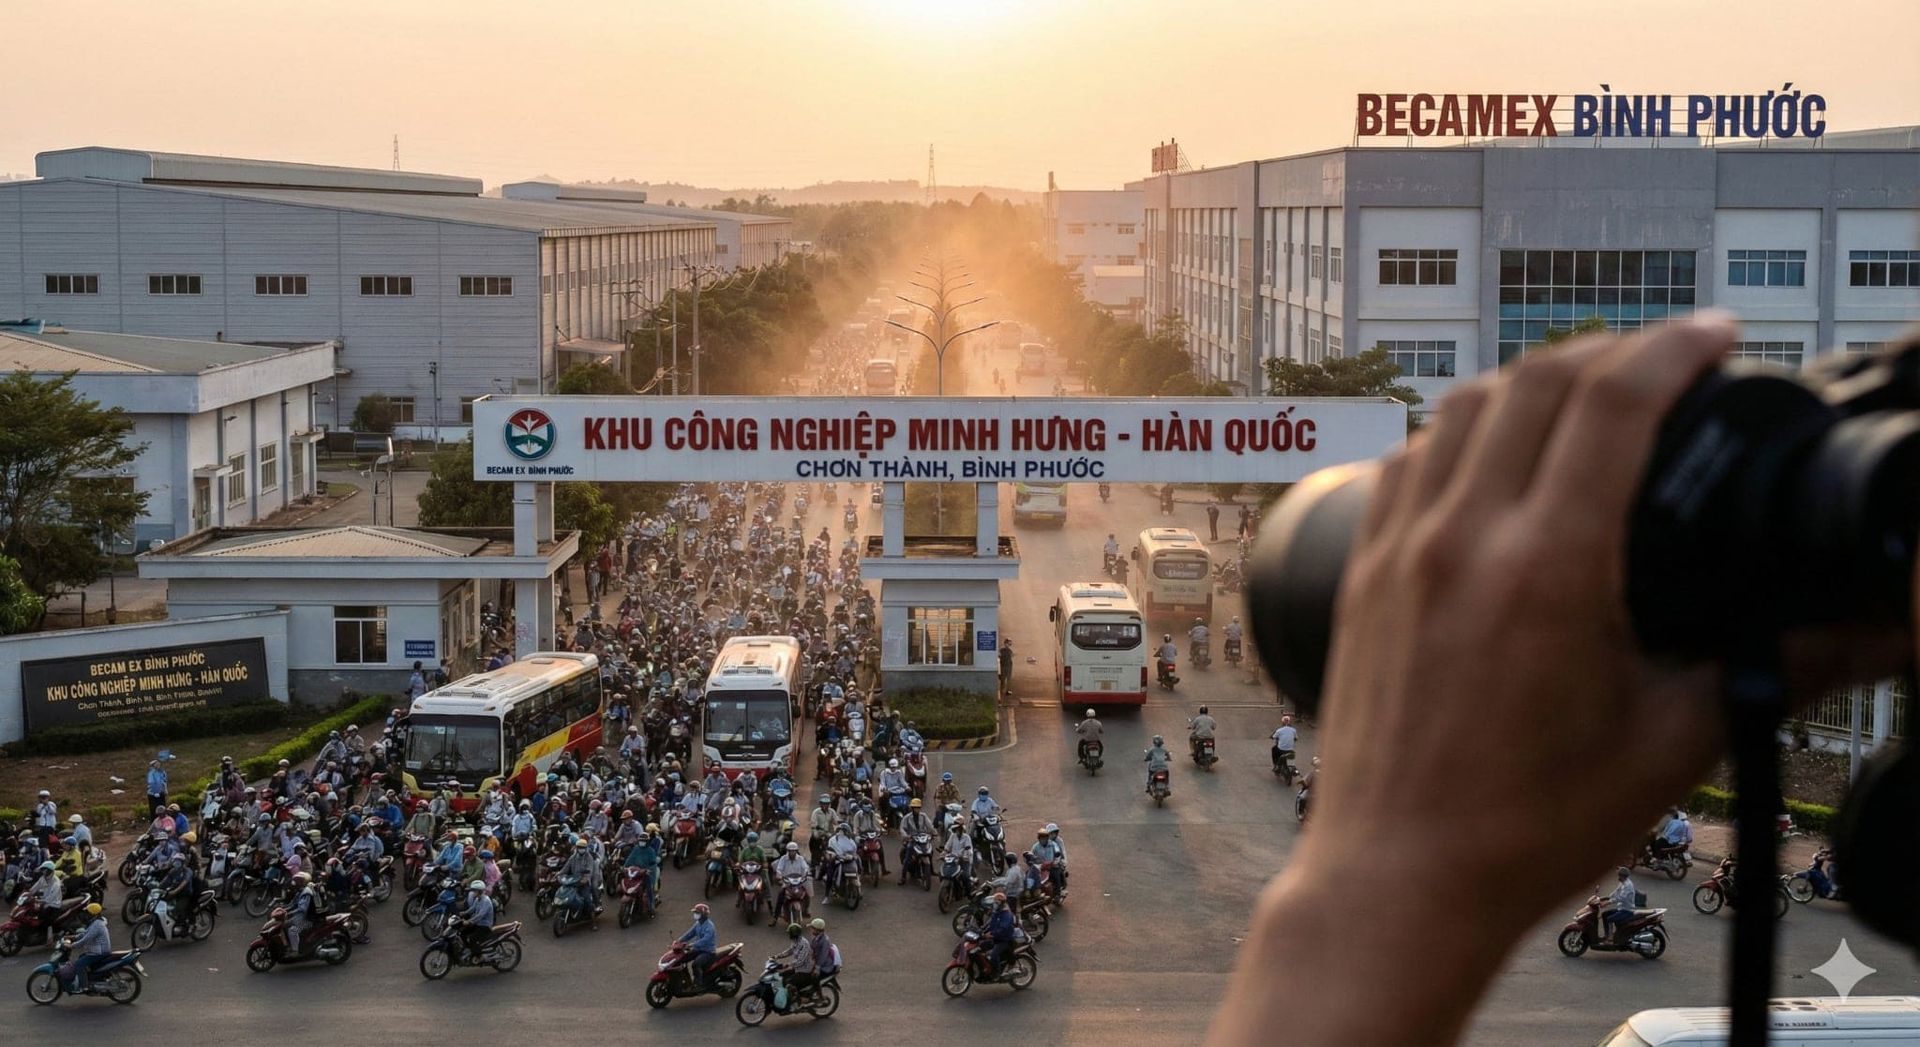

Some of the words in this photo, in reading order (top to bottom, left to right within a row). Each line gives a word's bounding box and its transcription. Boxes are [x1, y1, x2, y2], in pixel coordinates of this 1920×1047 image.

[1357, 93, 1558, 137] BECAMEX
[1573, 84, 1671, 138] BÌNH
[1687, 82, 1827, 138] PHƯỚC
[584, 417, 652, 450] KHU
[664, 409, 758, 451] CÔNG
[770, 411, 896, 459] NGHIỆP
[908, 418, 999, 451] MINH
[1011, 415, 1106, 451] HƯNG
[1117, 432, 1131, 441] -
[1142, 410, 1213, 451] HÀN
[1224, 406, 1316, 455] QUỐC
[486, 466, 514, 475] BECAM
[515, 466, 526, 475] EX
[796, 457, 862, 478] CHƠN
[869, 456, 955, 481] THÀNH,
[962, 456, 1016, 478] BÌNH
[1024, 456, 1105, 478] PHƯỚC
[47, 684, 68, 701] KHU
[70, 680, 98, 699] CÔNG
[100, 675, 136, 697] NGHIỆP
[139, 675, 165, 691] MINH
[200, 666, 221, 684] HÀN
[222, 660, 248, 683] QUỐC
[90, 661, 127, 677] BECAM
[128, 660, 142, 672] EX
[144, 655, 169, 671] BÌNH
[172, 650, 205, 667] PHƯỚC
